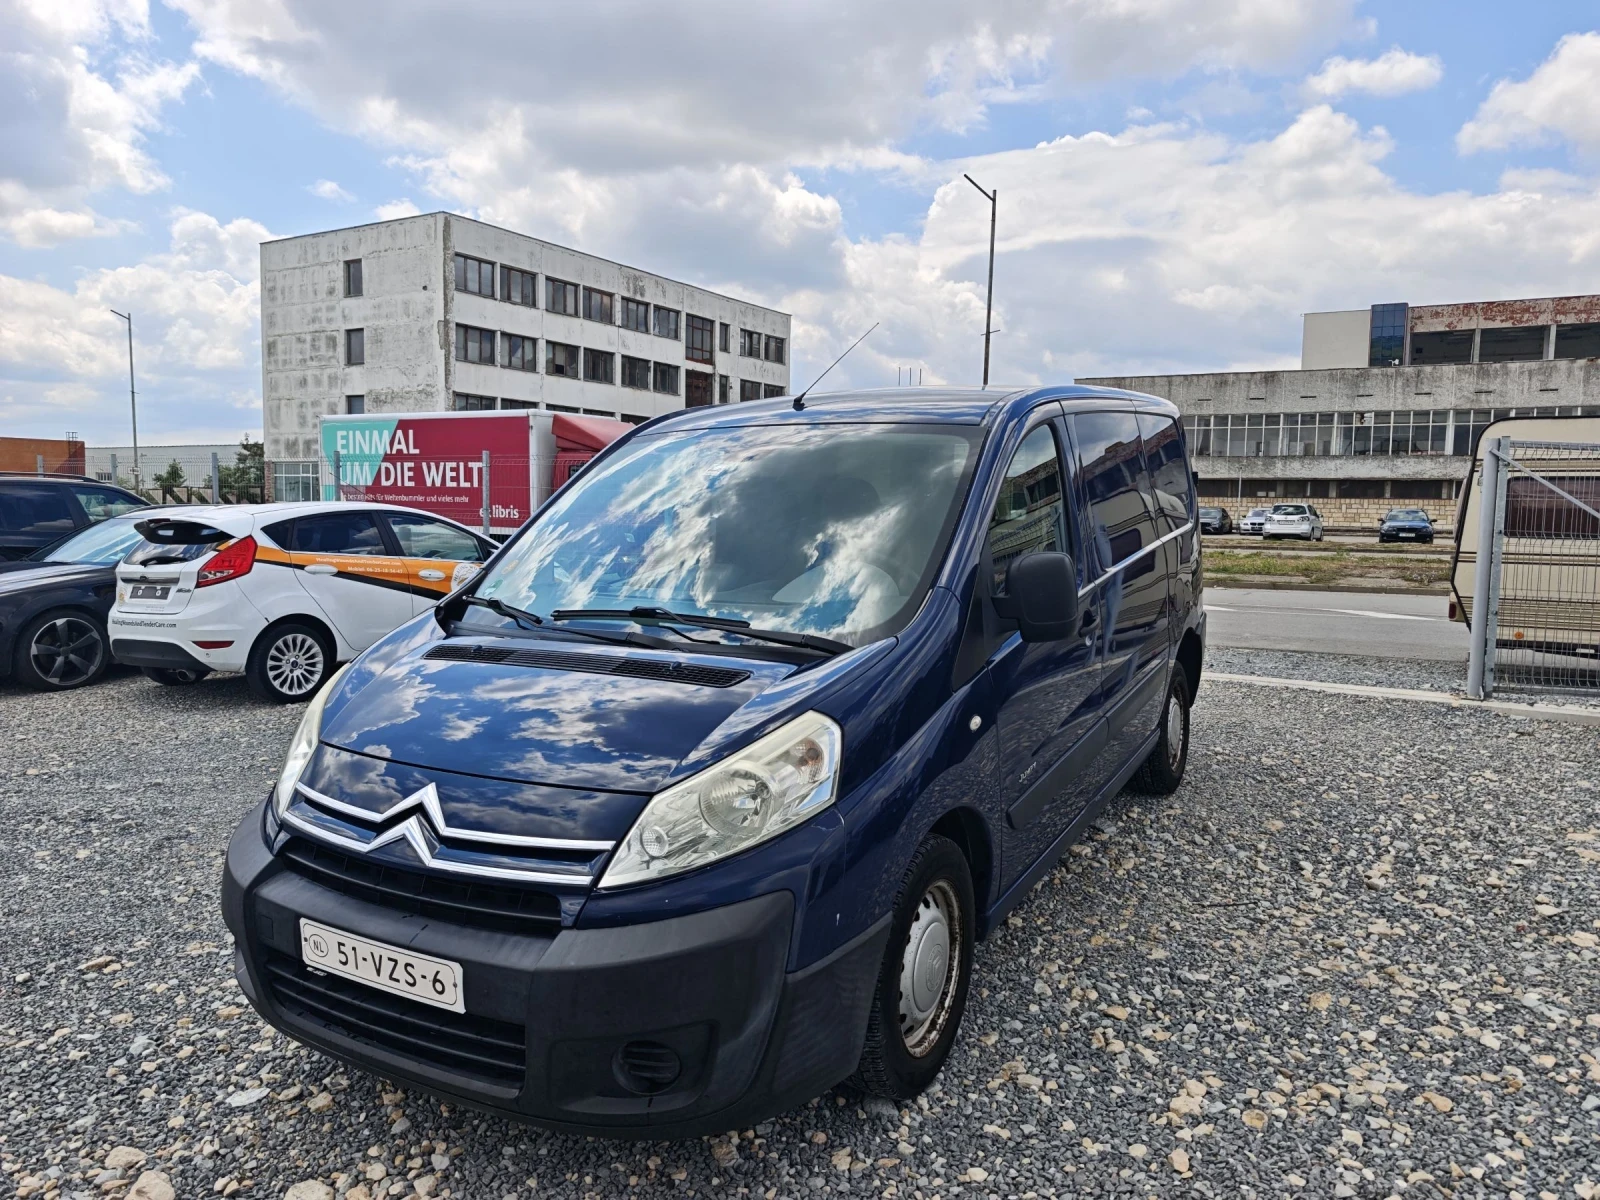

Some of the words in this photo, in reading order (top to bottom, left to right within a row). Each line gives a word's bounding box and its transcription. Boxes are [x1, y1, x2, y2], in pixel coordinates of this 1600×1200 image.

[336, 429, 420, 455] EINMAL
[339, 461, 373, 486] UM
[380, 461, 416, 487] DIE
[421, 461, 483, 488] WELT
[385, 494, 425, 502] Weltenbummler
[426, 494, 437, 502] und
[438, 494, 453, 503] vieles
[454, 495, 469, 503] mehr
[492, 504, 519, 519] libris
[313, 940, 325, 953] NL
[337, 941, 446, 996] 51-VZS-6
